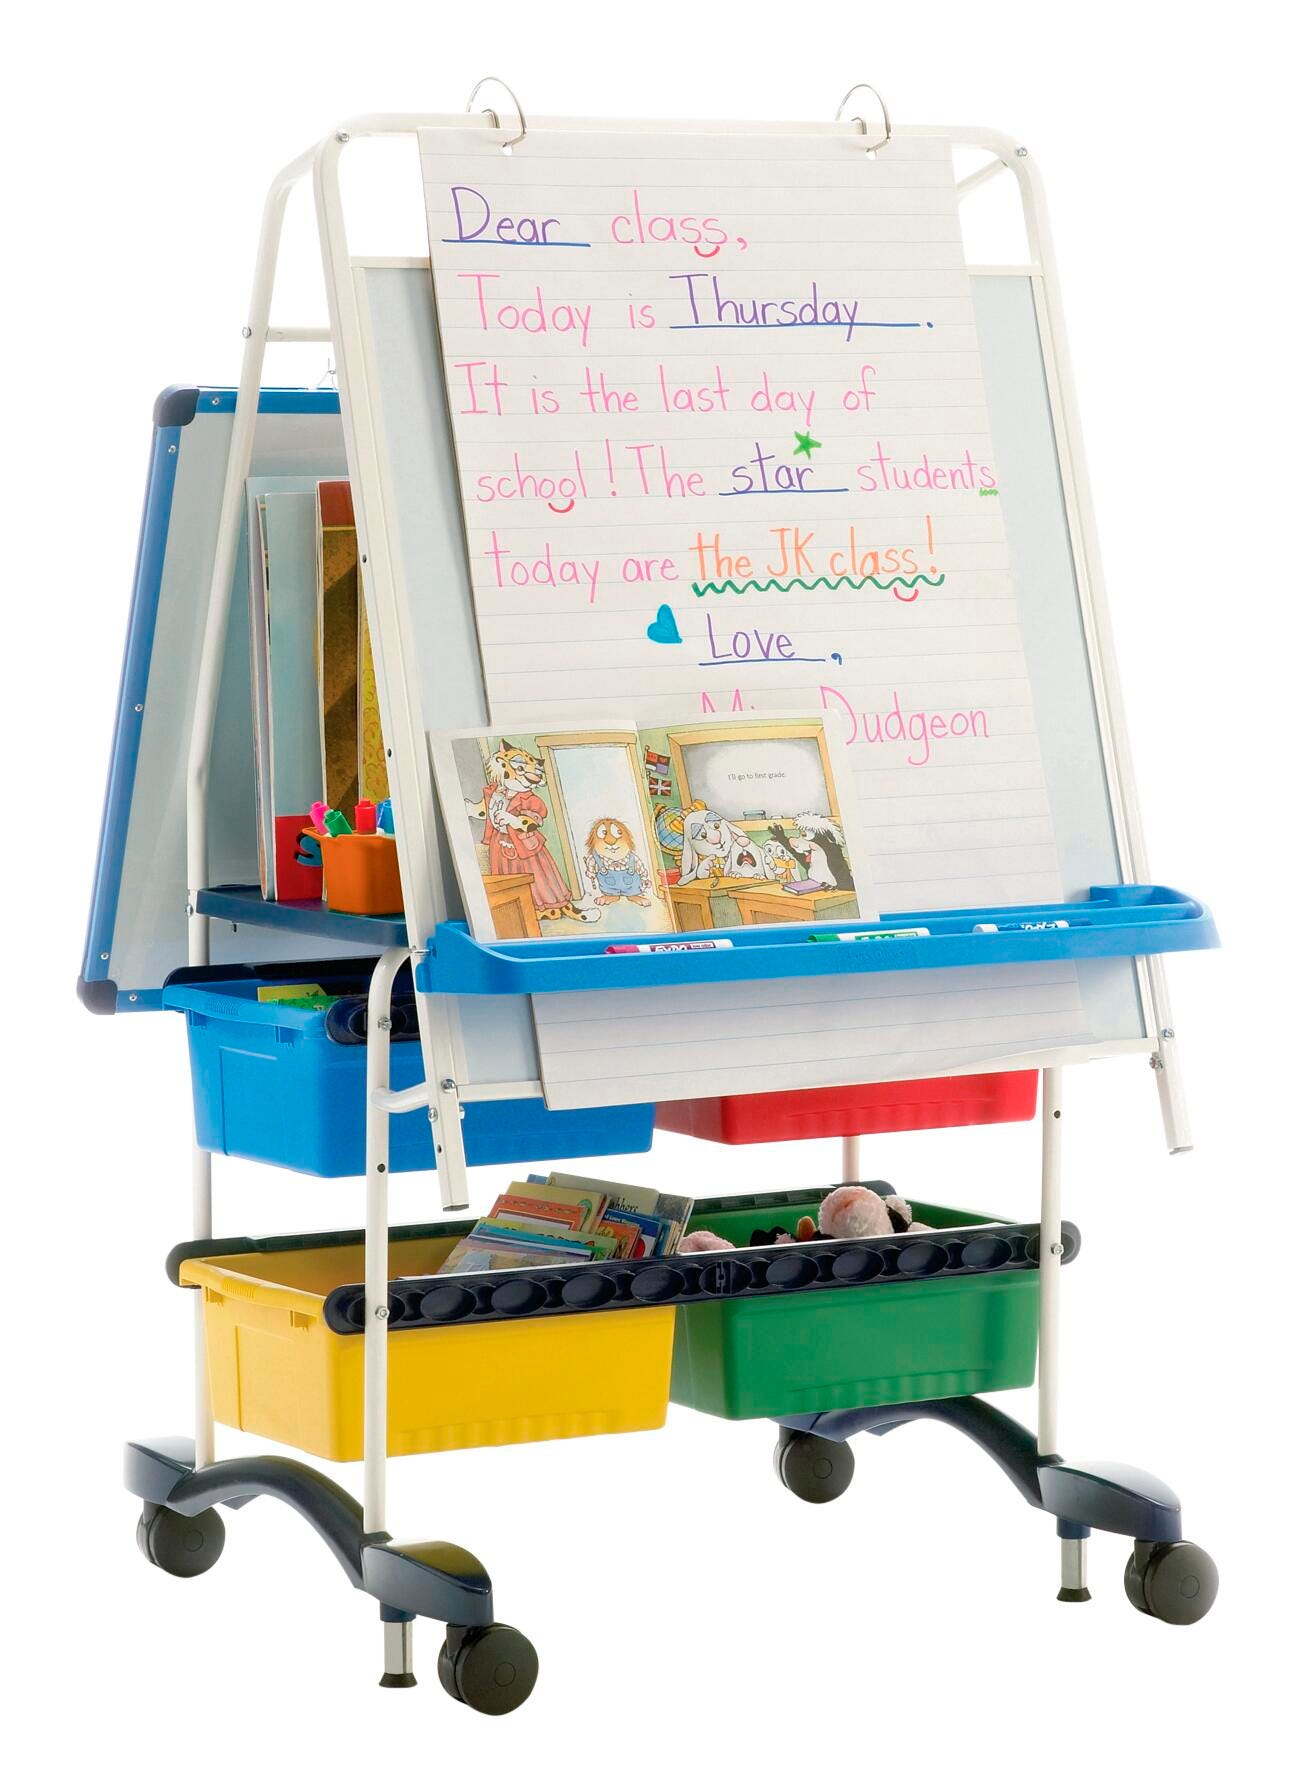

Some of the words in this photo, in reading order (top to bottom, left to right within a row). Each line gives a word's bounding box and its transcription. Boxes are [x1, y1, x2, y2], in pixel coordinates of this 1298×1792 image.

[450, 186, 561, 246] Dear
[610, 189, 750, 252] class,
[457, 272, 592, 348] Today
[627, 292, 657, 330] is
[453, 361, 508, 417] It
[530, 375, 561, 417] is
[578, 367, 640, 414] the
[656, 364, 730, 413] last
[748, 370, 817, 428] day
[841, 364, 877, 414] of
[626, 444, 706, 499] The
[730, 442, 814, 493] star
[856, 440, 998, 493] students
[484, 530, 601, 605] today
[620, 556, 680, 586] are
[688, 530, 755, 581] the
[767, 526, 815, 578] JK
[828, 513, 939, 578] class!
